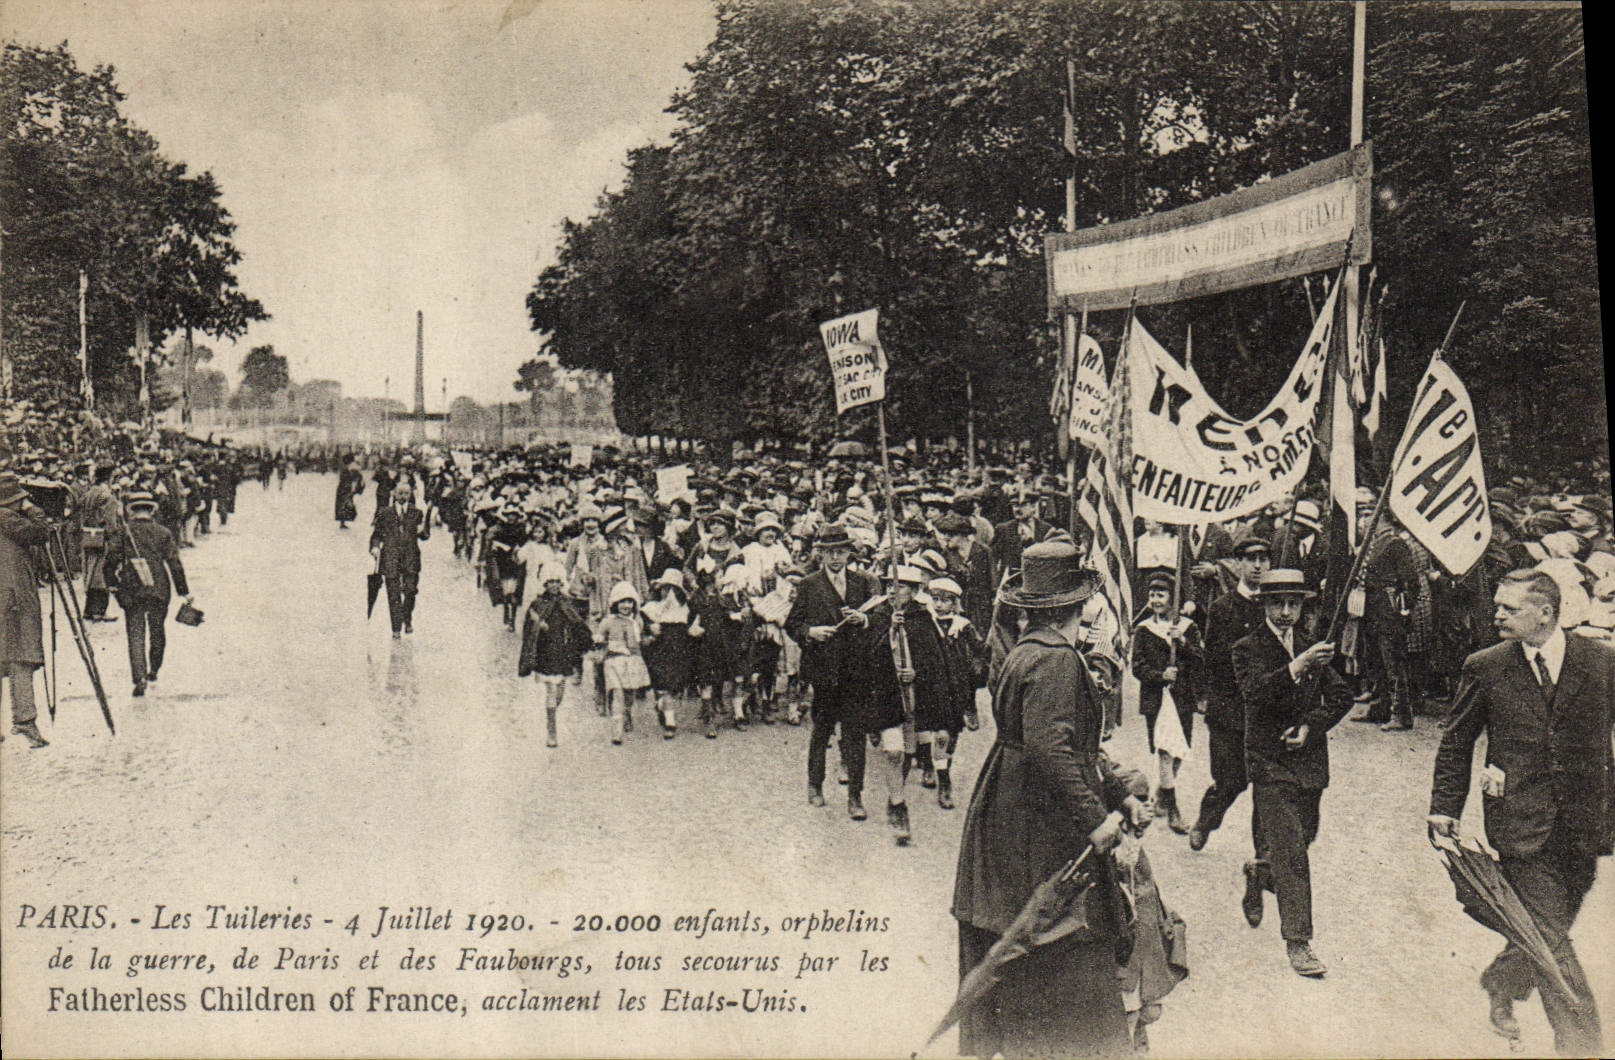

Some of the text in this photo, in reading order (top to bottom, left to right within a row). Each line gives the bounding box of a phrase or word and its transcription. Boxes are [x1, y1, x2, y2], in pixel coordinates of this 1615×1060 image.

[826, 320, 860, 349] IOWA
[850, 385, 873, 401] CITY
[1401, 431, 1486, 542] Arr.
